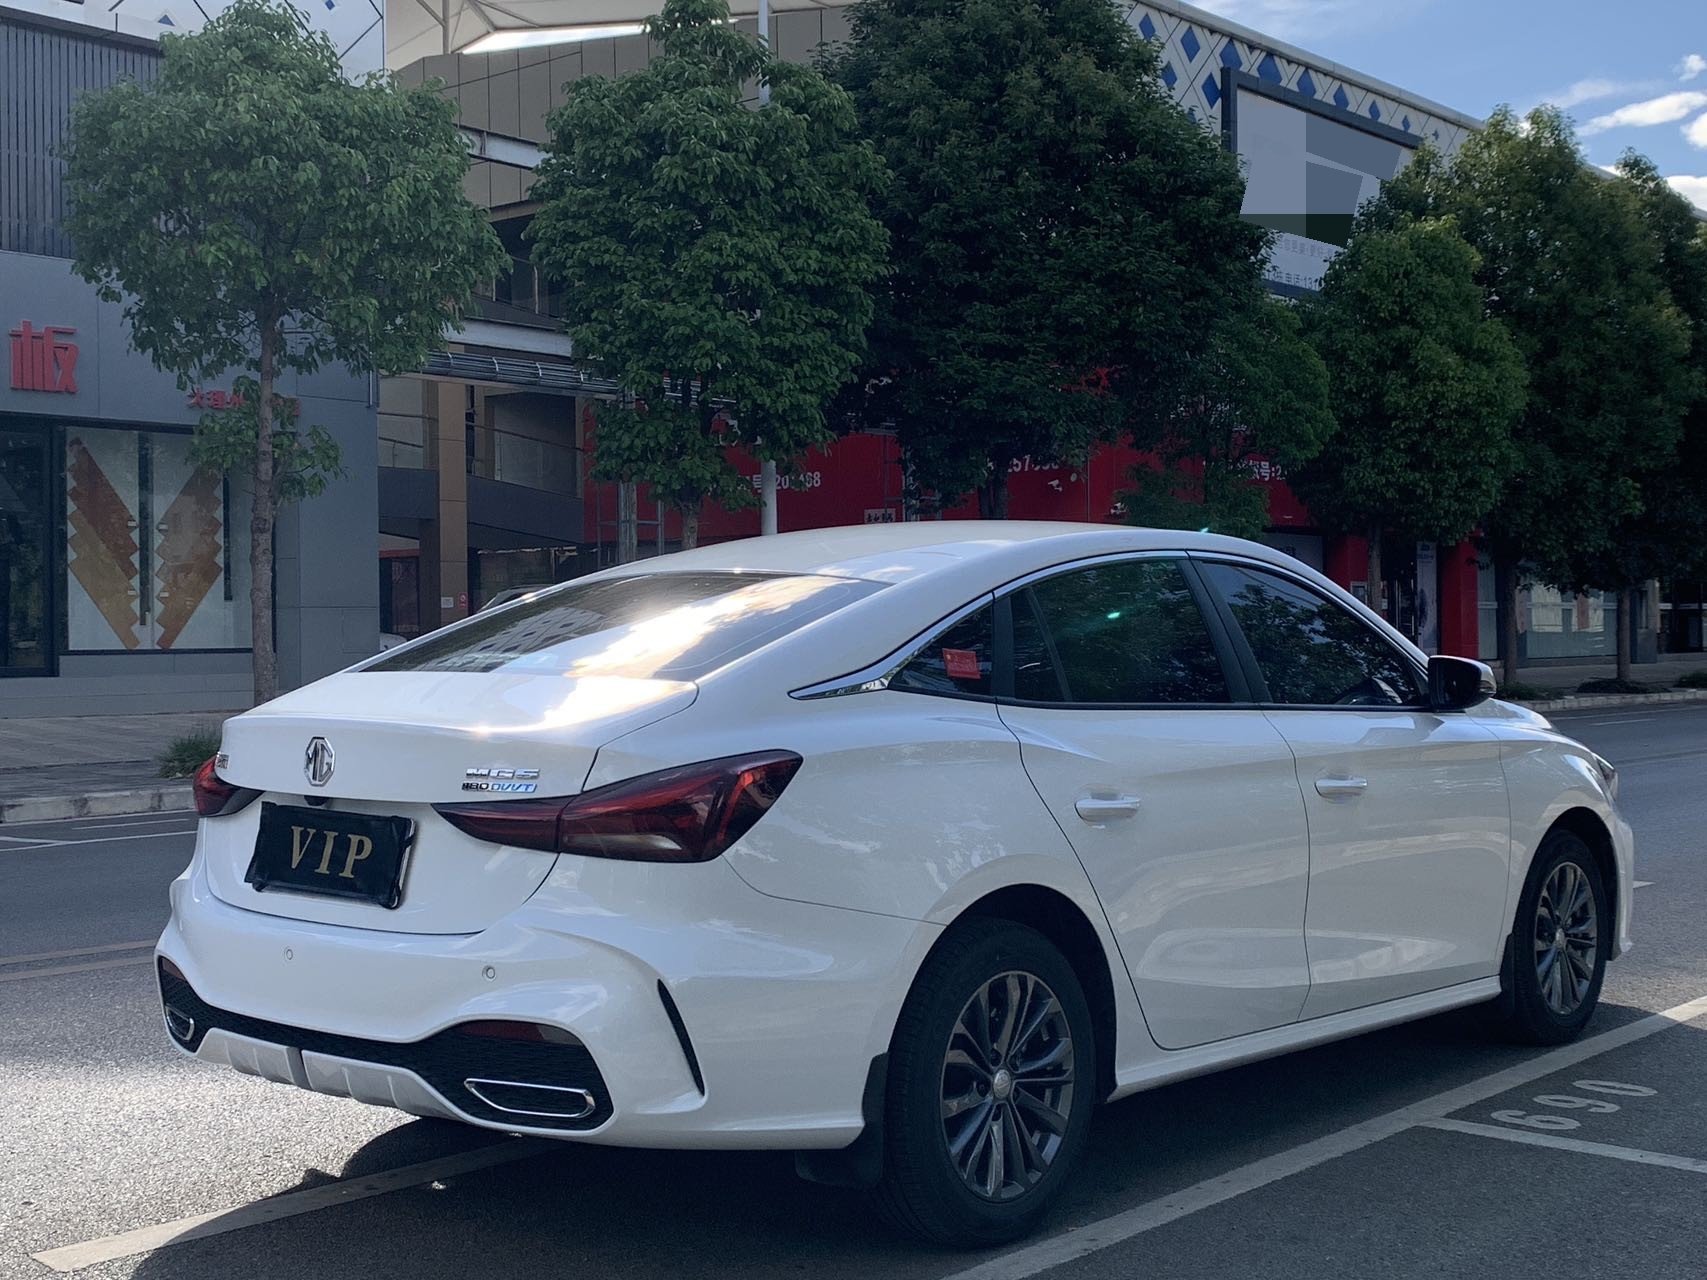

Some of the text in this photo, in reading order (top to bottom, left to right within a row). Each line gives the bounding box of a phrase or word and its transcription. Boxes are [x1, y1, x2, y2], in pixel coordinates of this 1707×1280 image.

[304, 736, 335, 786] MG
[290, 825, 373, 879] VIP
[1490, 1079, 1658, 1130] 690
